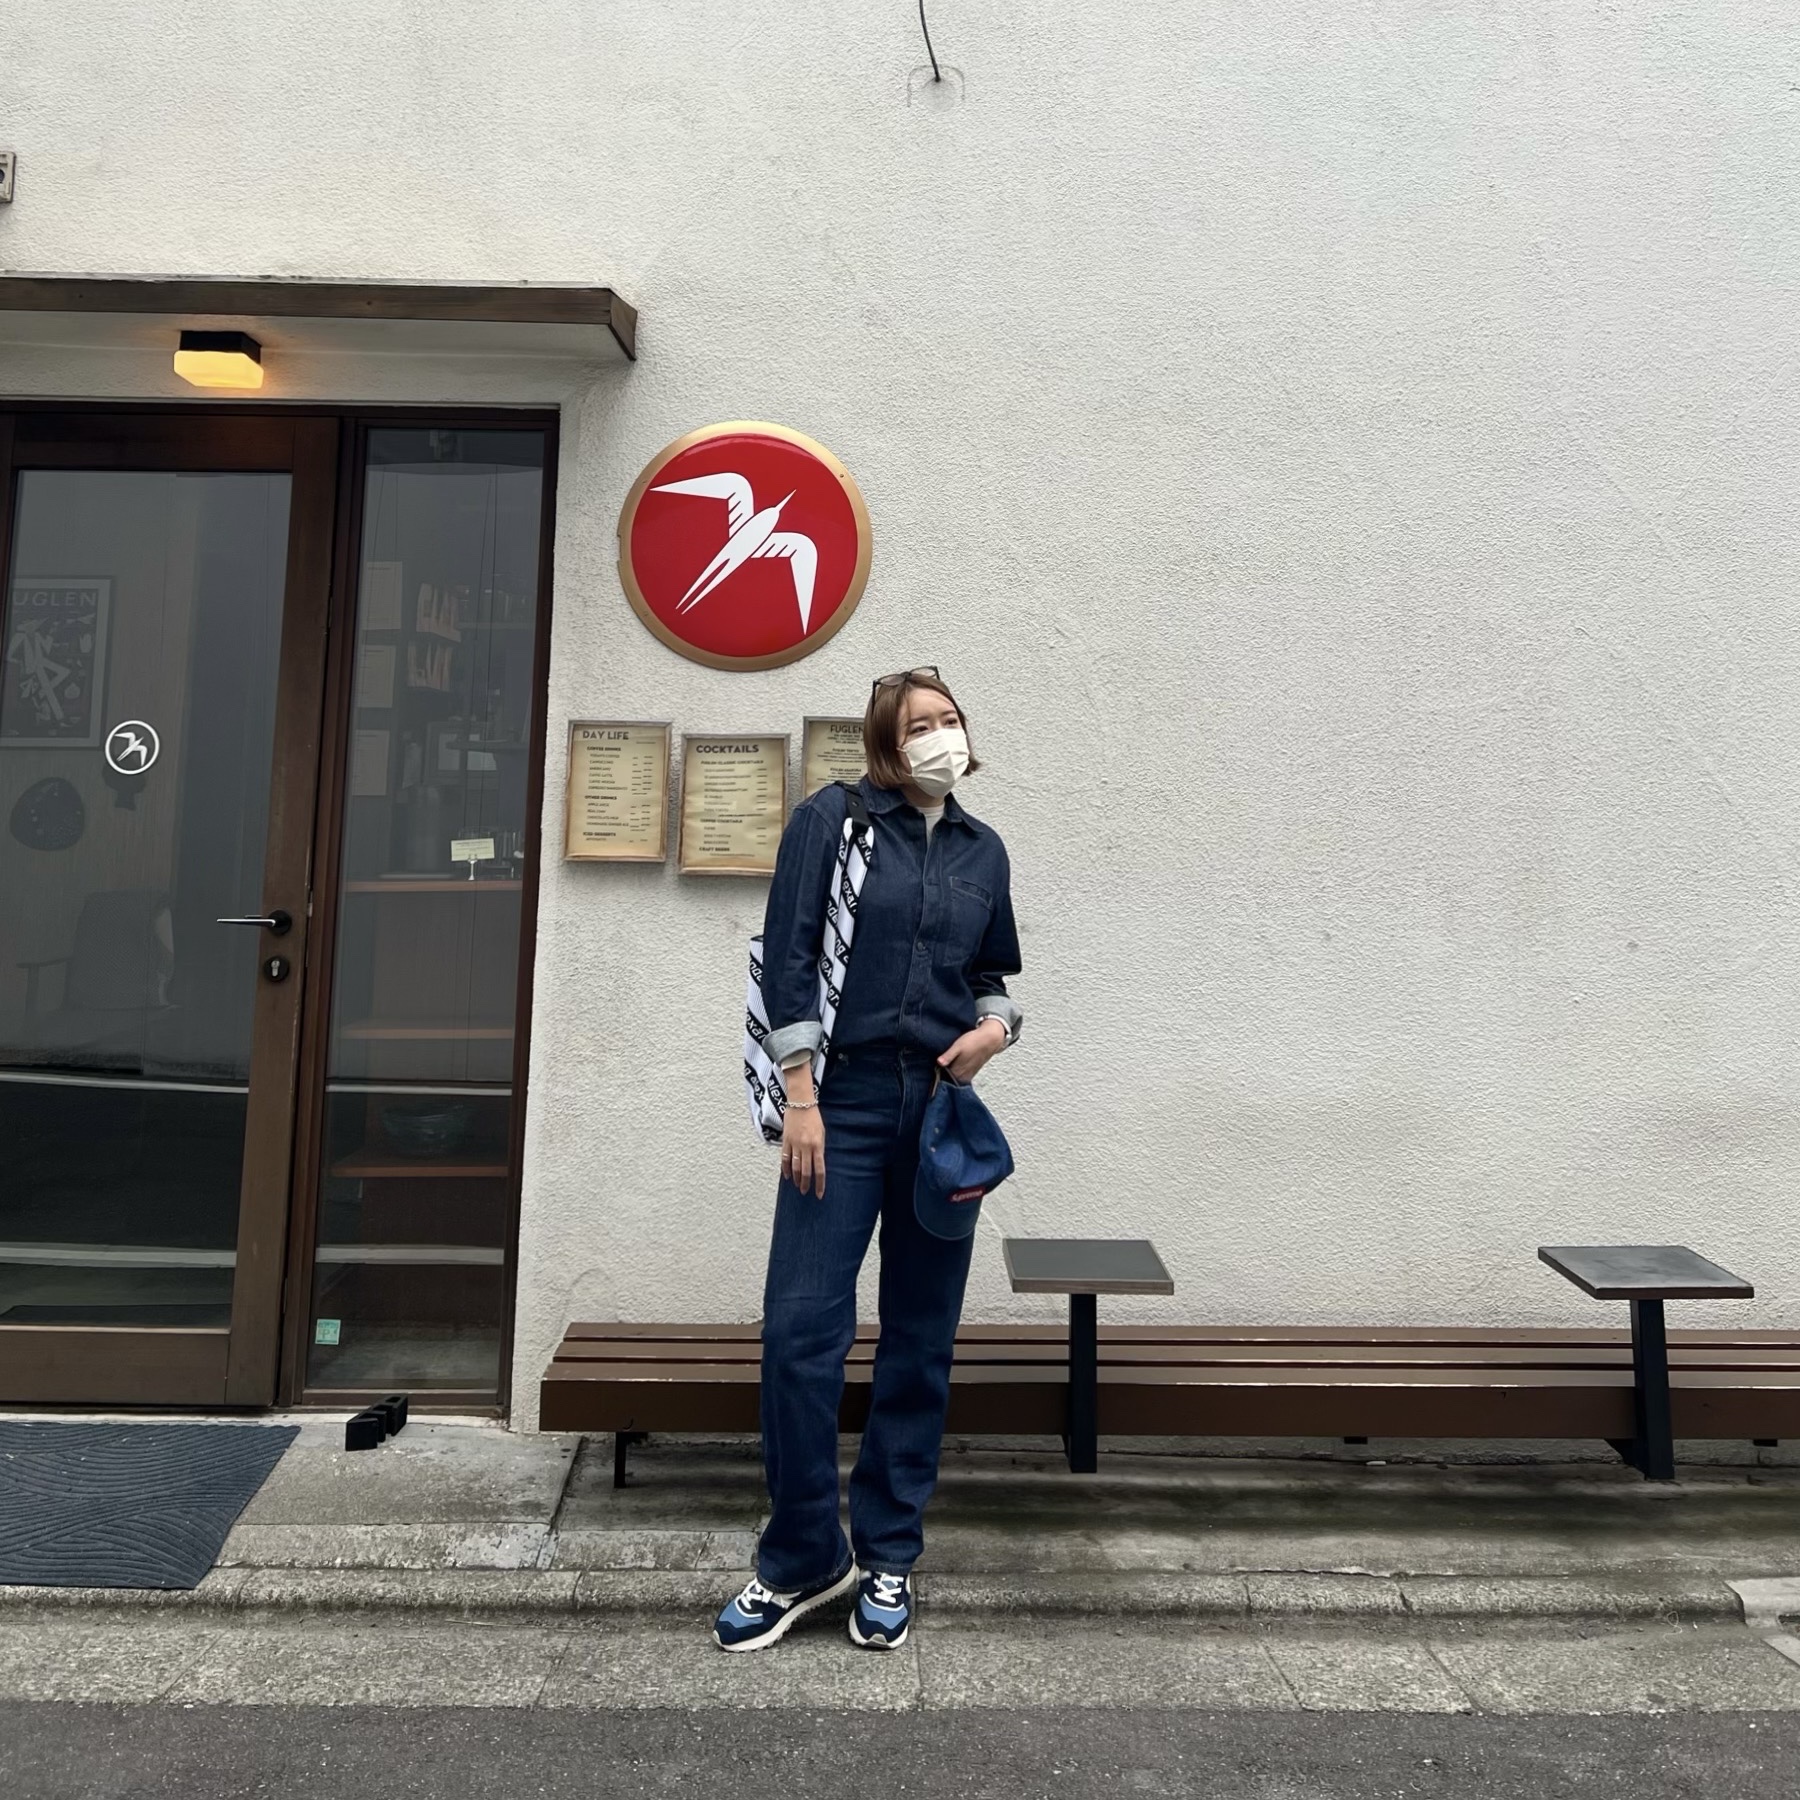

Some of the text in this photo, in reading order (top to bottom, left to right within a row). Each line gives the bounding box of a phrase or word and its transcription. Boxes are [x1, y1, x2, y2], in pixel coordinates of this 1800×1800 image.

[13, 591, 97, 606] UGLEN
[582, 730, 629, 740] DAY LIFE
[696, 744, 759, 753] COCKTAILS
